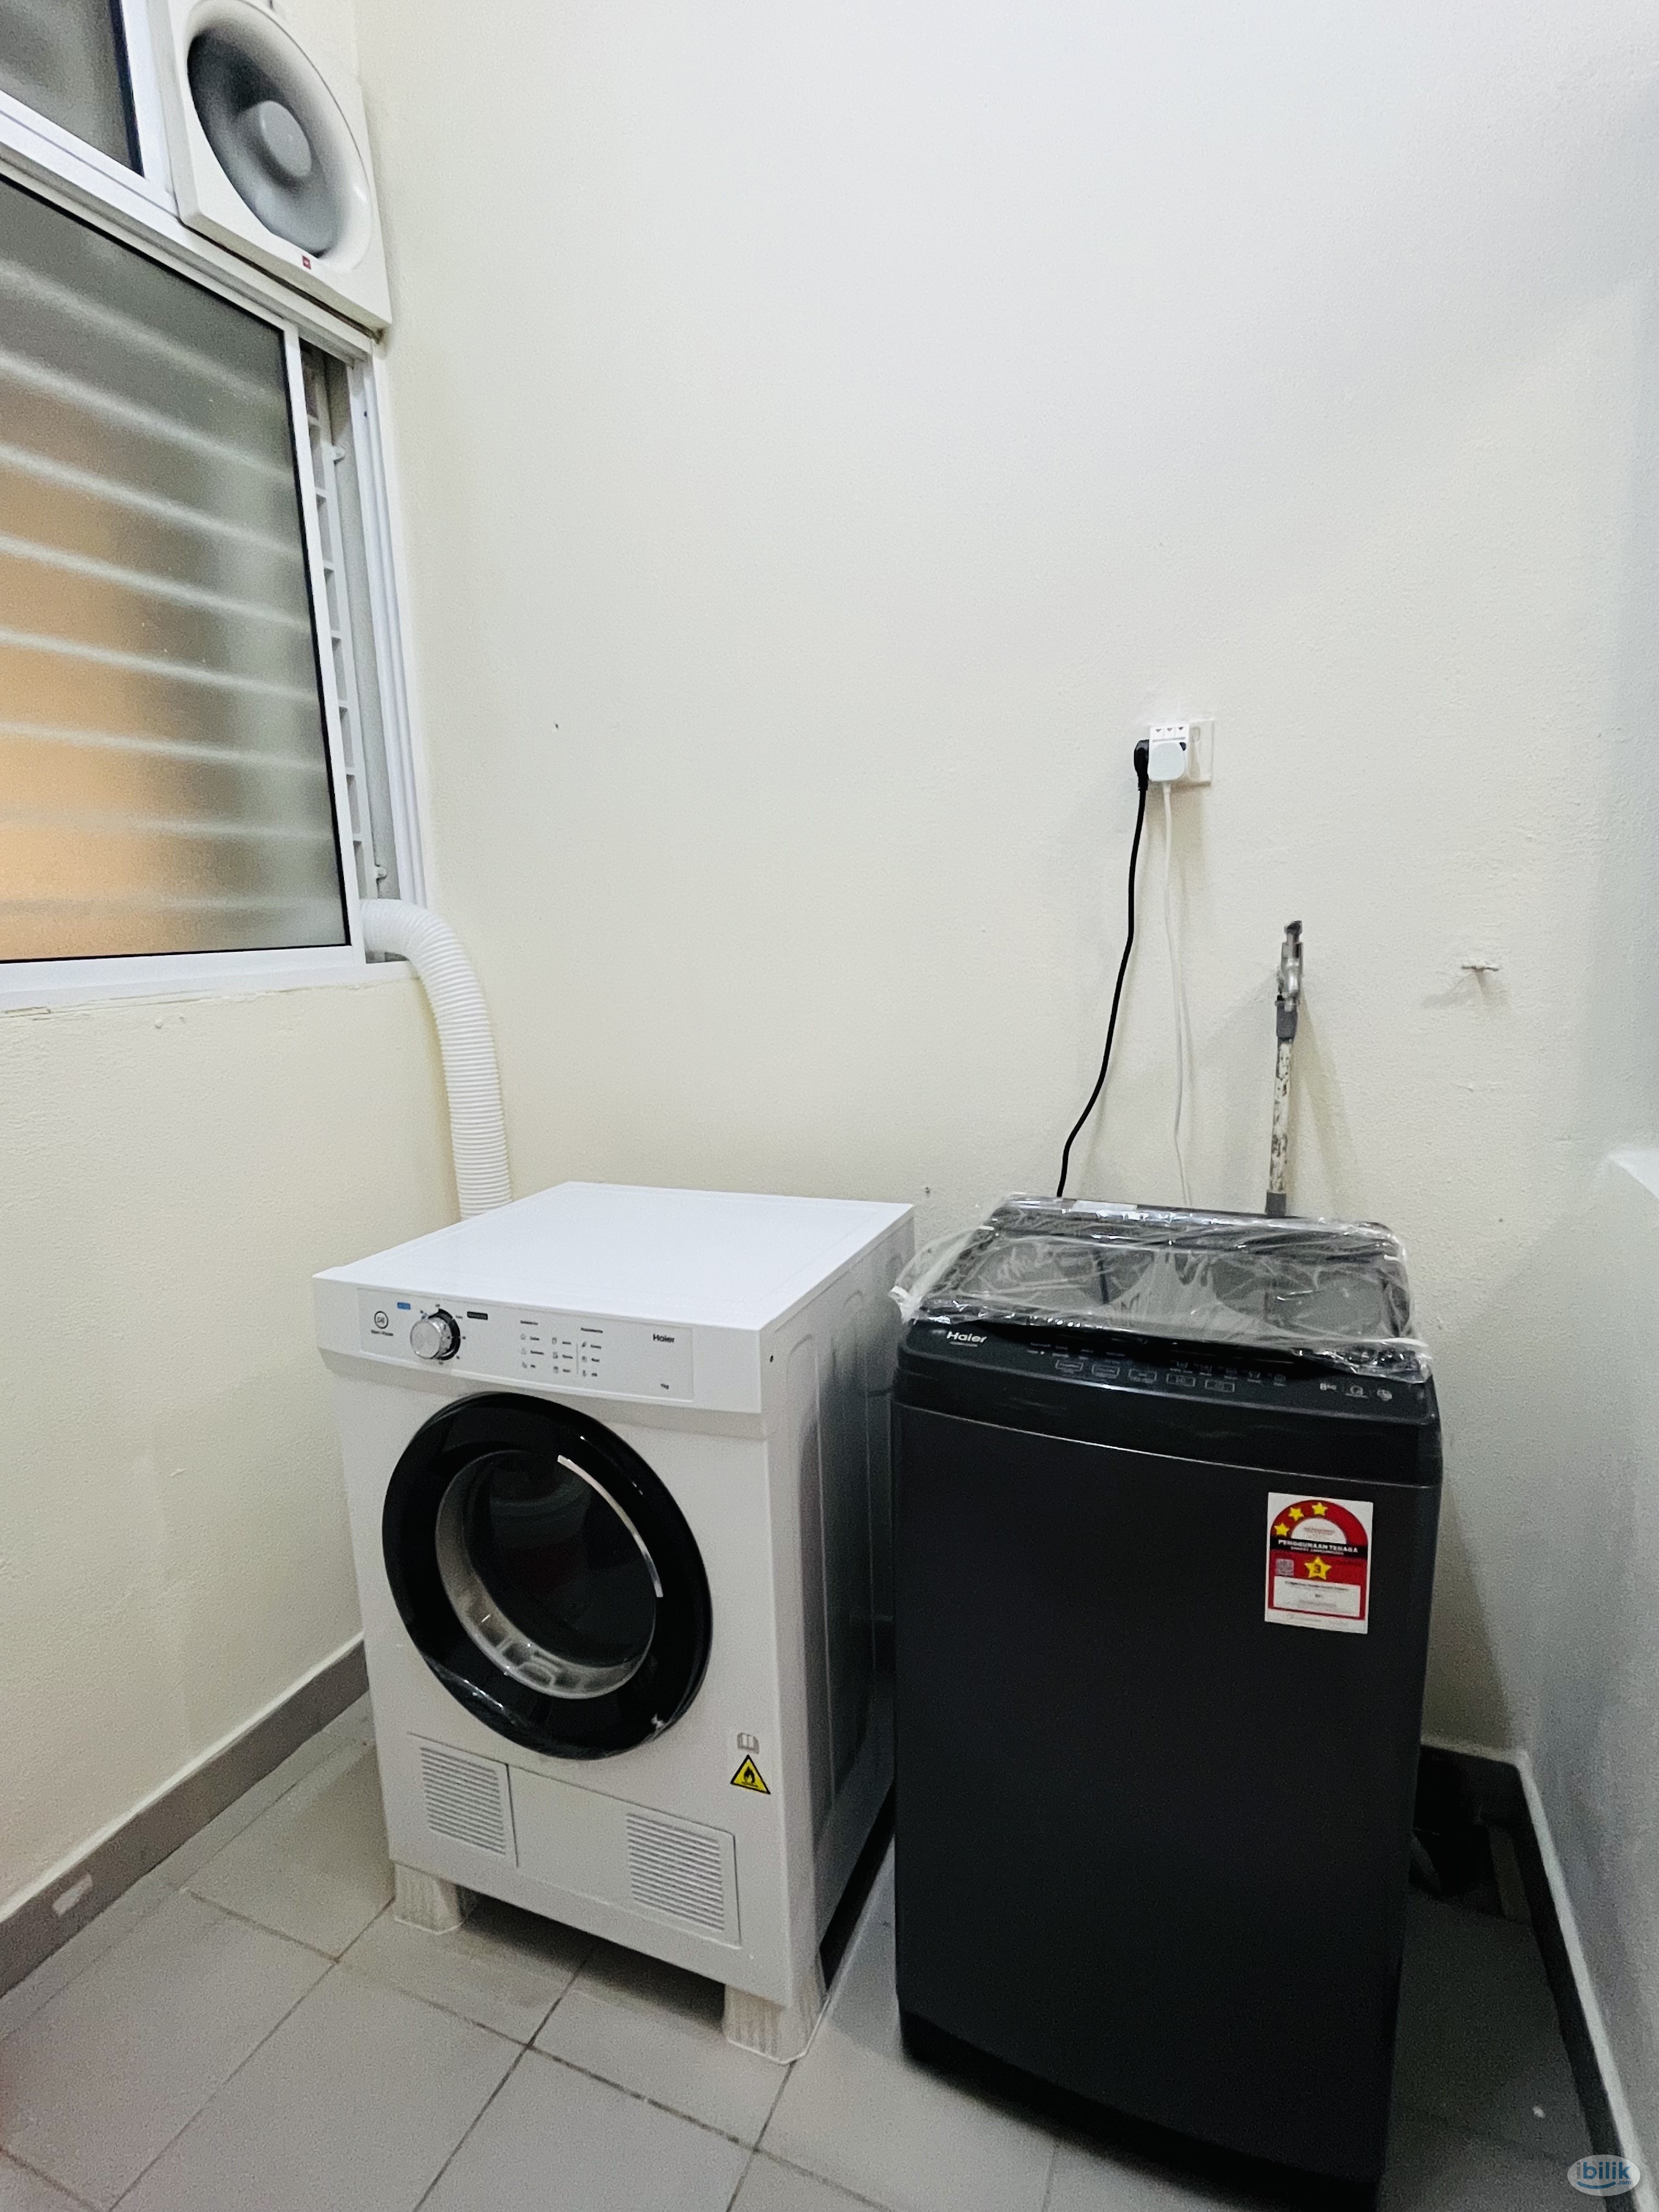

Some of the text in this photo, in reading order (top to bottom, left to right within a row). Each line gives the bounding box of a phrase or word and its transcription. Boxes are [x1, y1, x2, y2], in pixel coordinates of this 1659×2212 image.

[653, 1334, 675, 1343] Haier
[946, 1331, 988, 1343] Haier
[1278, 1539, 1328, 1550] PENGGUNAAN
[1329, 1544, 1358, 1553] TENAGA
